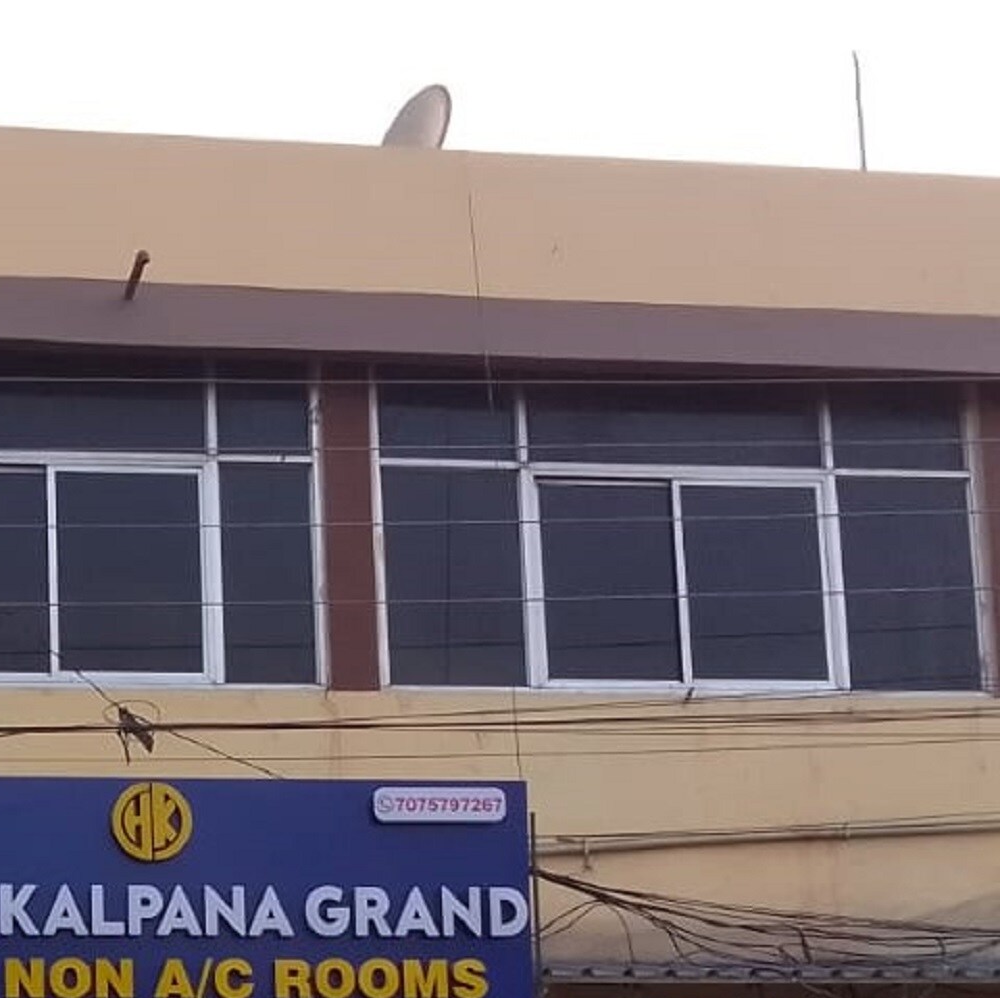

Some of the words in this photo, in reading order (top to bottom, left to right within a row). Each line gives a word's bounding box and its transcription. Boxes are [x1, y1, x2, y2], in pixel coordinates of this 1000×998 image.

[395, 797, 501, 812] 7075797267
[0, 884, 295, 937] KALPANA
[305, 885, 529, 937] GRAND
